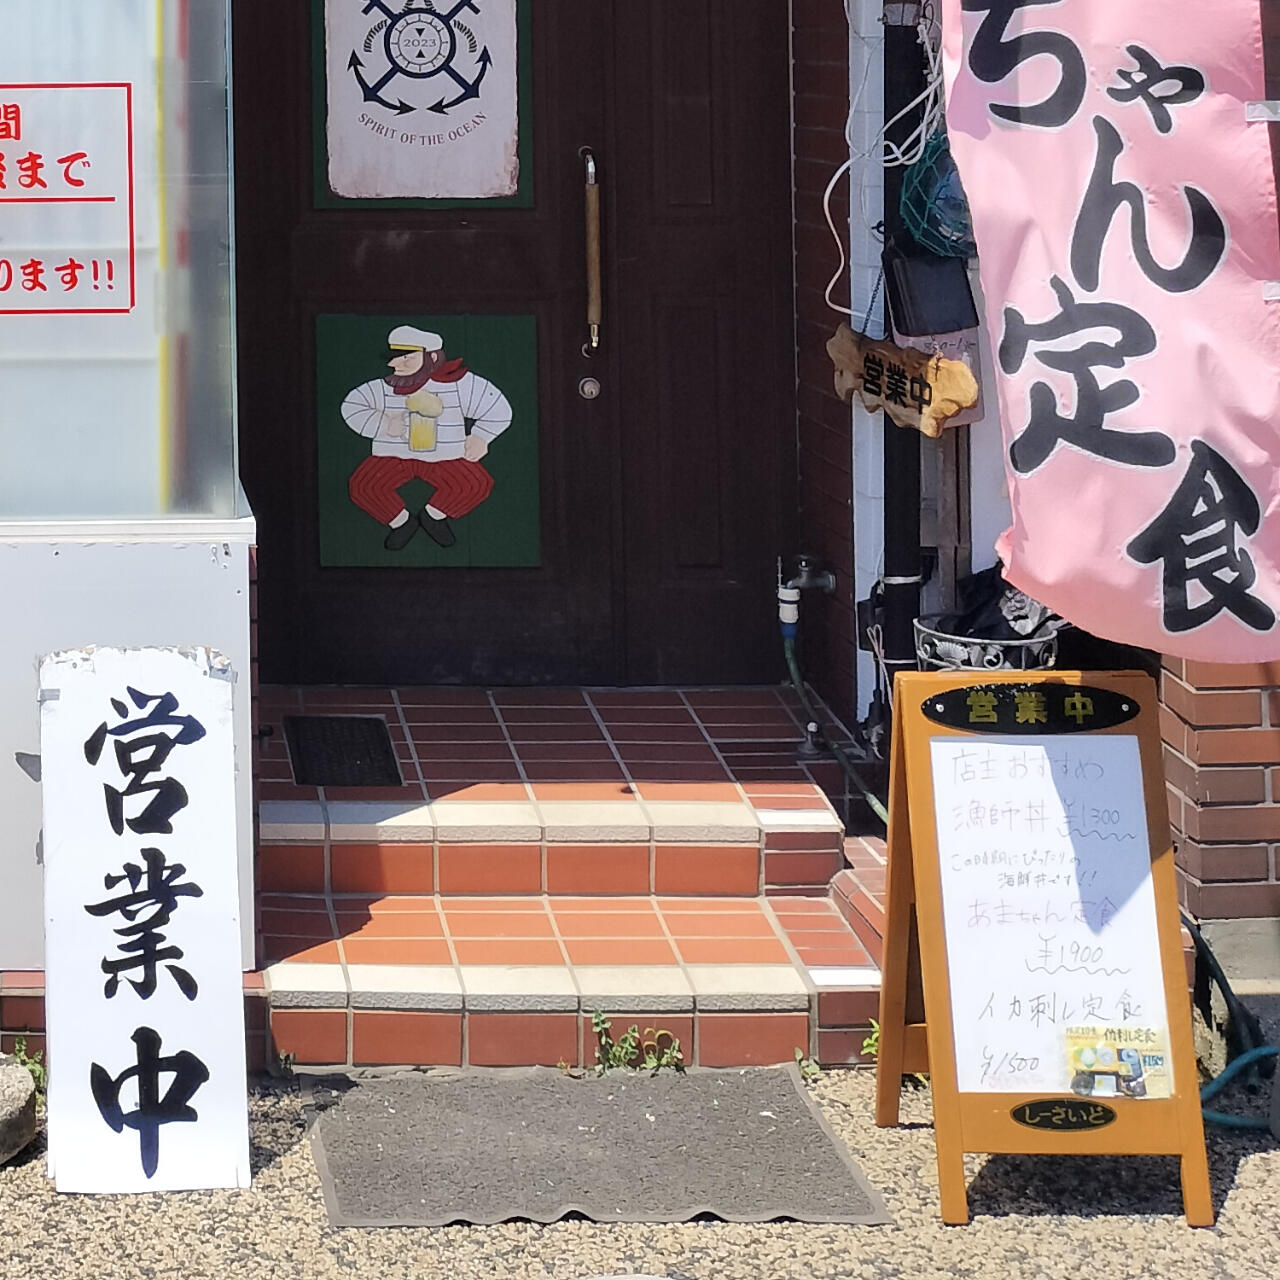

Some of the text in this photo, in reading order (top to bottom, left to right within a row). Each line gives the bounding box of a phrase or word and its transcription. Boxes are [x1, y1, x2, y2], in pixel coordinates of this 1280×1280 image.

[403, 38, 437, 48] 2023
[358, 111, 488, 146] SPIRIT OF THE OCEAN
[862, 351, 933, 415] 営業中
[966, 690, 1095, 725] 営業中
[951, 748, 1105, 785] 店主おすすめ
[951, 799, 1051, 832] 漁師丼
[967, 896, 1120, 929] あまちゃん定食
[83, 685, 212, 1180] 営業中
[1038, 932, 1104, 967] ¥1900
[978, 989, 1142, 1028] イカ刺し定食
[1024, 1105, 1106, 1124] しーさいど
